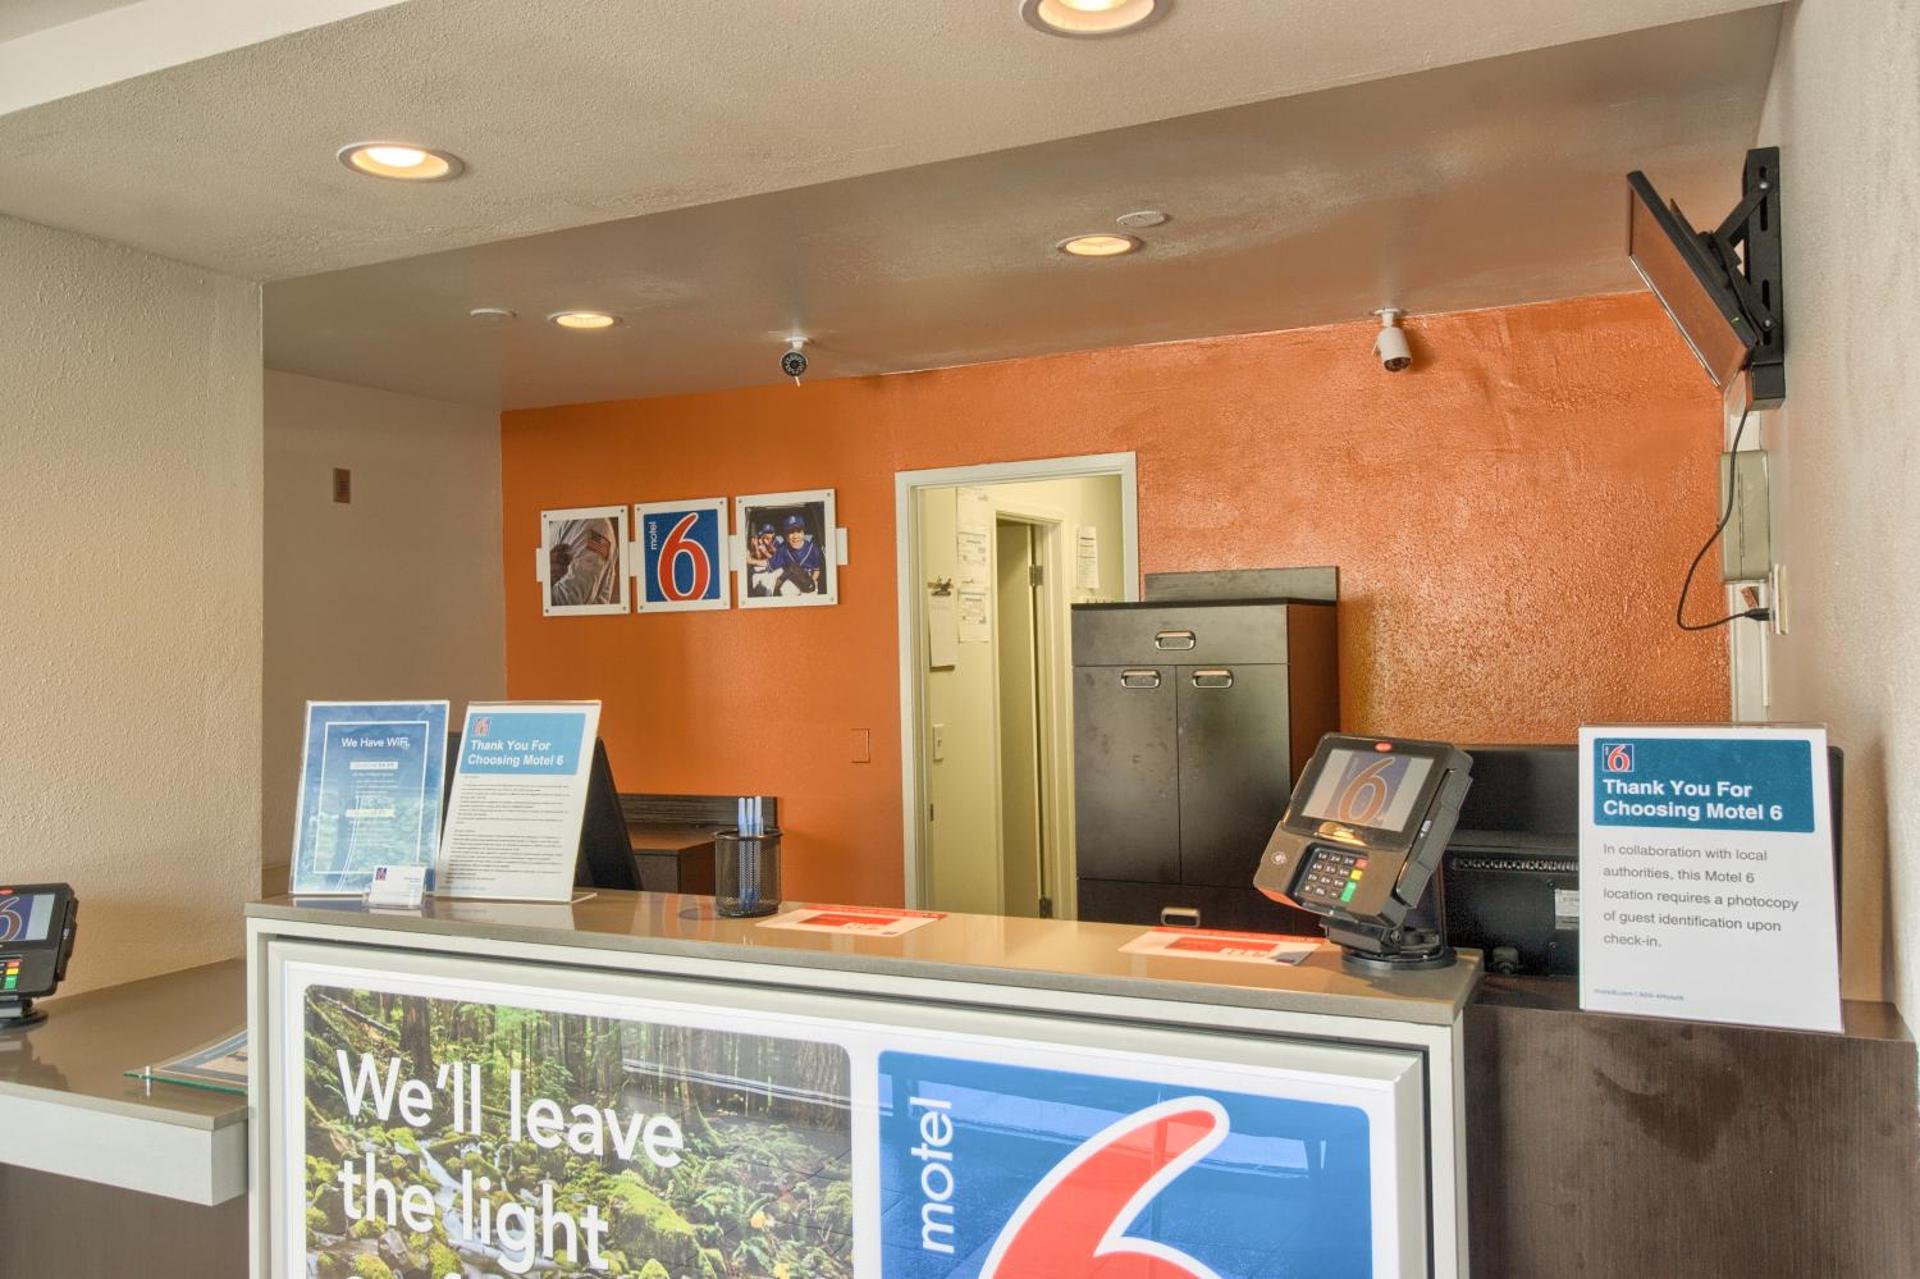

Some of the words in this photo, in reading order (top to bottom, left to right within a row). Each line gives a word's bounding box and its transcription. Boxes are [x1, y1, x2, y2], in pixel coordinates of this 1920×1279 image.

[658, 512, 711, 602] 6
[341, 736, 358, 748] We
[360, 736, 385, 748] Have
[470, 739, 504, 751] Thank
[507, 740, 529, 751] You
[531, 740, 552, 751] For
[467, 754, 520, 767] Choosing
[523, 755, 554, 766] Motel
[1607, 744, 1630, 771] 6
[1338, 756, 1396, 826] 6
[1603, 778, 1664, 796] Thank
[1670, 780, 1711, 797] You
[1717, 781, 1752, 798] For
[1603, 800, 1701, 822] Choosing
[1706, 802, 1764, 821] Motel
[1769, 804, 1783, 821] 6
[1603, 843, 1615, 855] In
[1618, 844, 1701, 859] collaboration
[1705, 847, 1732, 860] with
[1736, 849, 1768, 862] local
[1603, 866, 1674, 881] authorities,
[1677, 869, 1701, 881] this
[1705, 871, 1742, 883] Motel
[1746, 872, 1755, 884] 6
[1603, 888, 1653, 901] location
[1657, 890, 1711, 906] requires
[1714, 895, 1723, 905] a
[1727, 894, 1799, 912] photocopy
[1603, 910, 1616, 922] of
[1619, 912, 1656, 926] guest
[1658, 913, 1743, 930] identification
[1746, 920, 1782, 934] upon
[1603, 933, 1662, 948] check-in.
[336, 1049, 481, 1136] We'll
[510, 1068, 684, 1168] leave
[909, 1096, 955, 1255] motel
[337, 1152, 435, 1233] the
[462, 1169, 609, 1275] light
